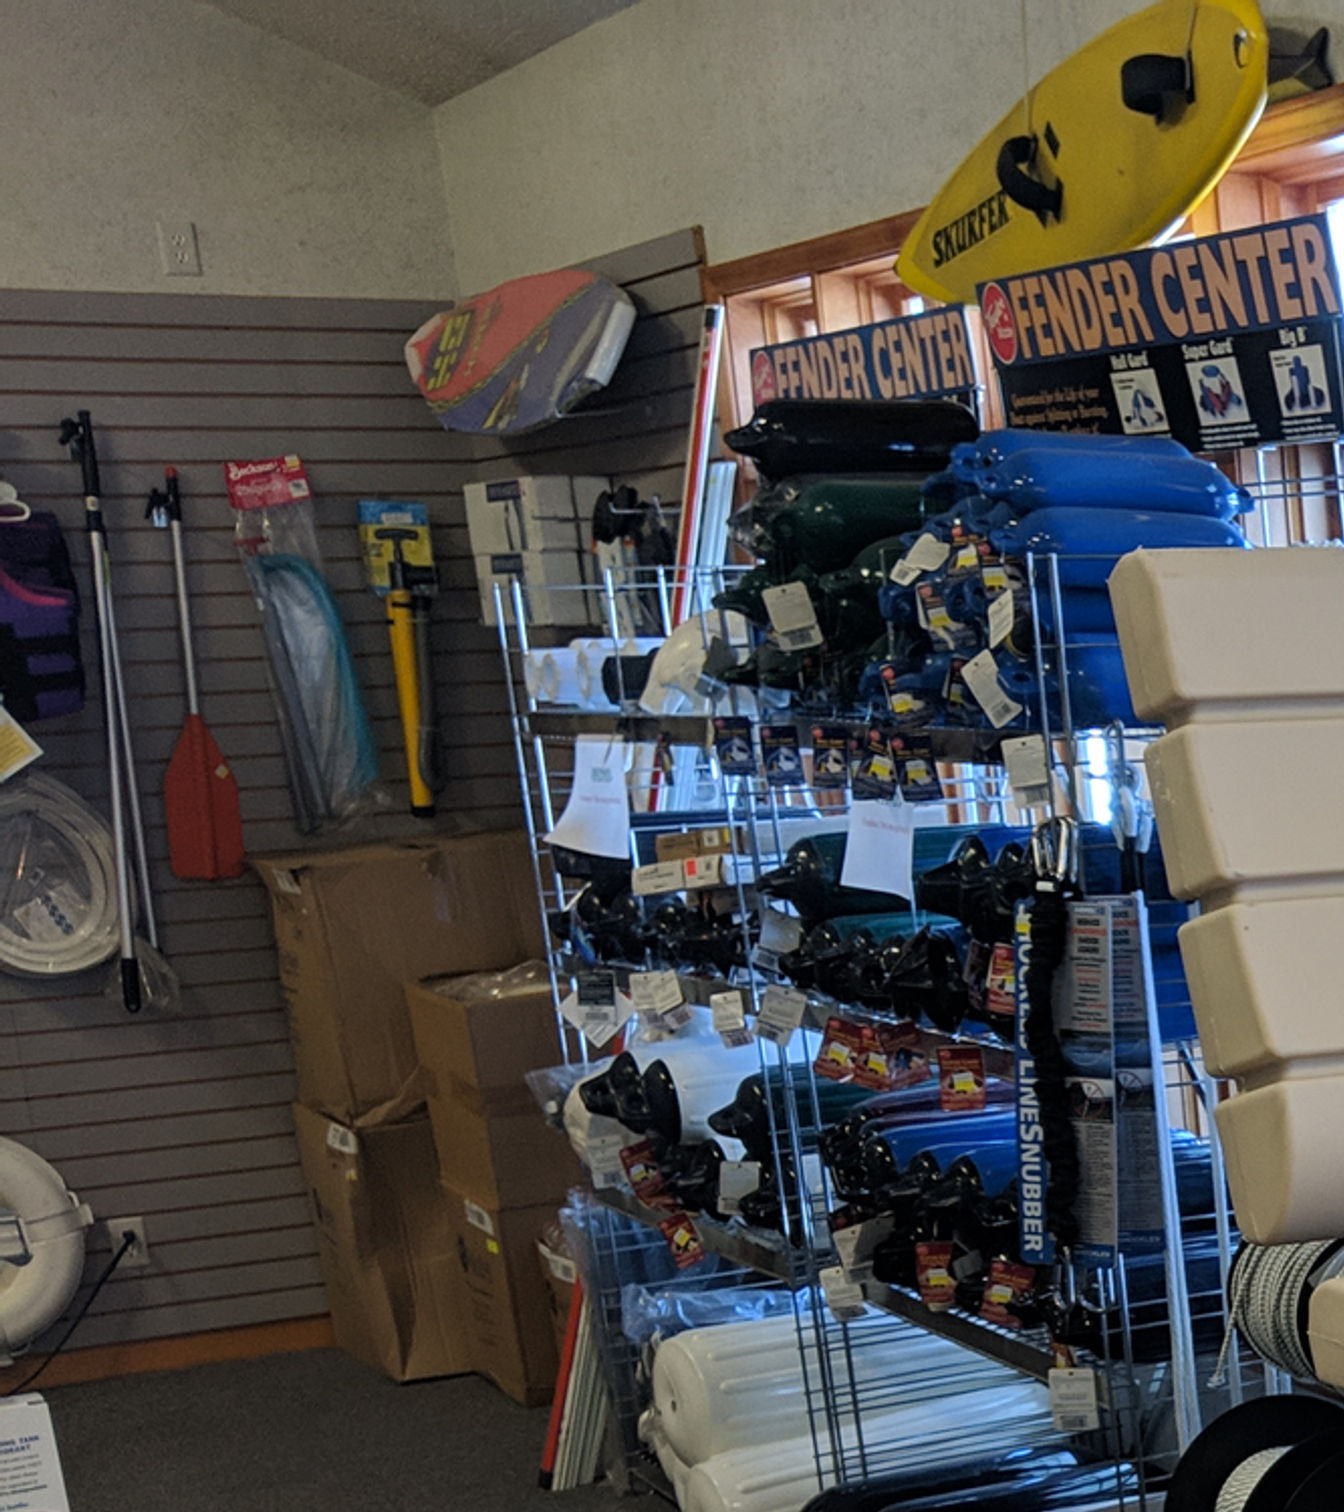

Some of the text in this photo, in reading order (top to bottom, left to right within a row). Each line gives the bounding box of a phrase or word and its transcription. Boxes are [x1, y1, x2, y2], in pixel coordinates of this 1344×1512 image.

[932, 189, 1010, 268] SKURFER
[1009, 222, 1340, 360] FENDER CENTER
[773, 334, 872, 400] FENDER
[871, 311, 974, 399] CENTER
[1019, 1059, 1044, 1252] LINESNUBBER
